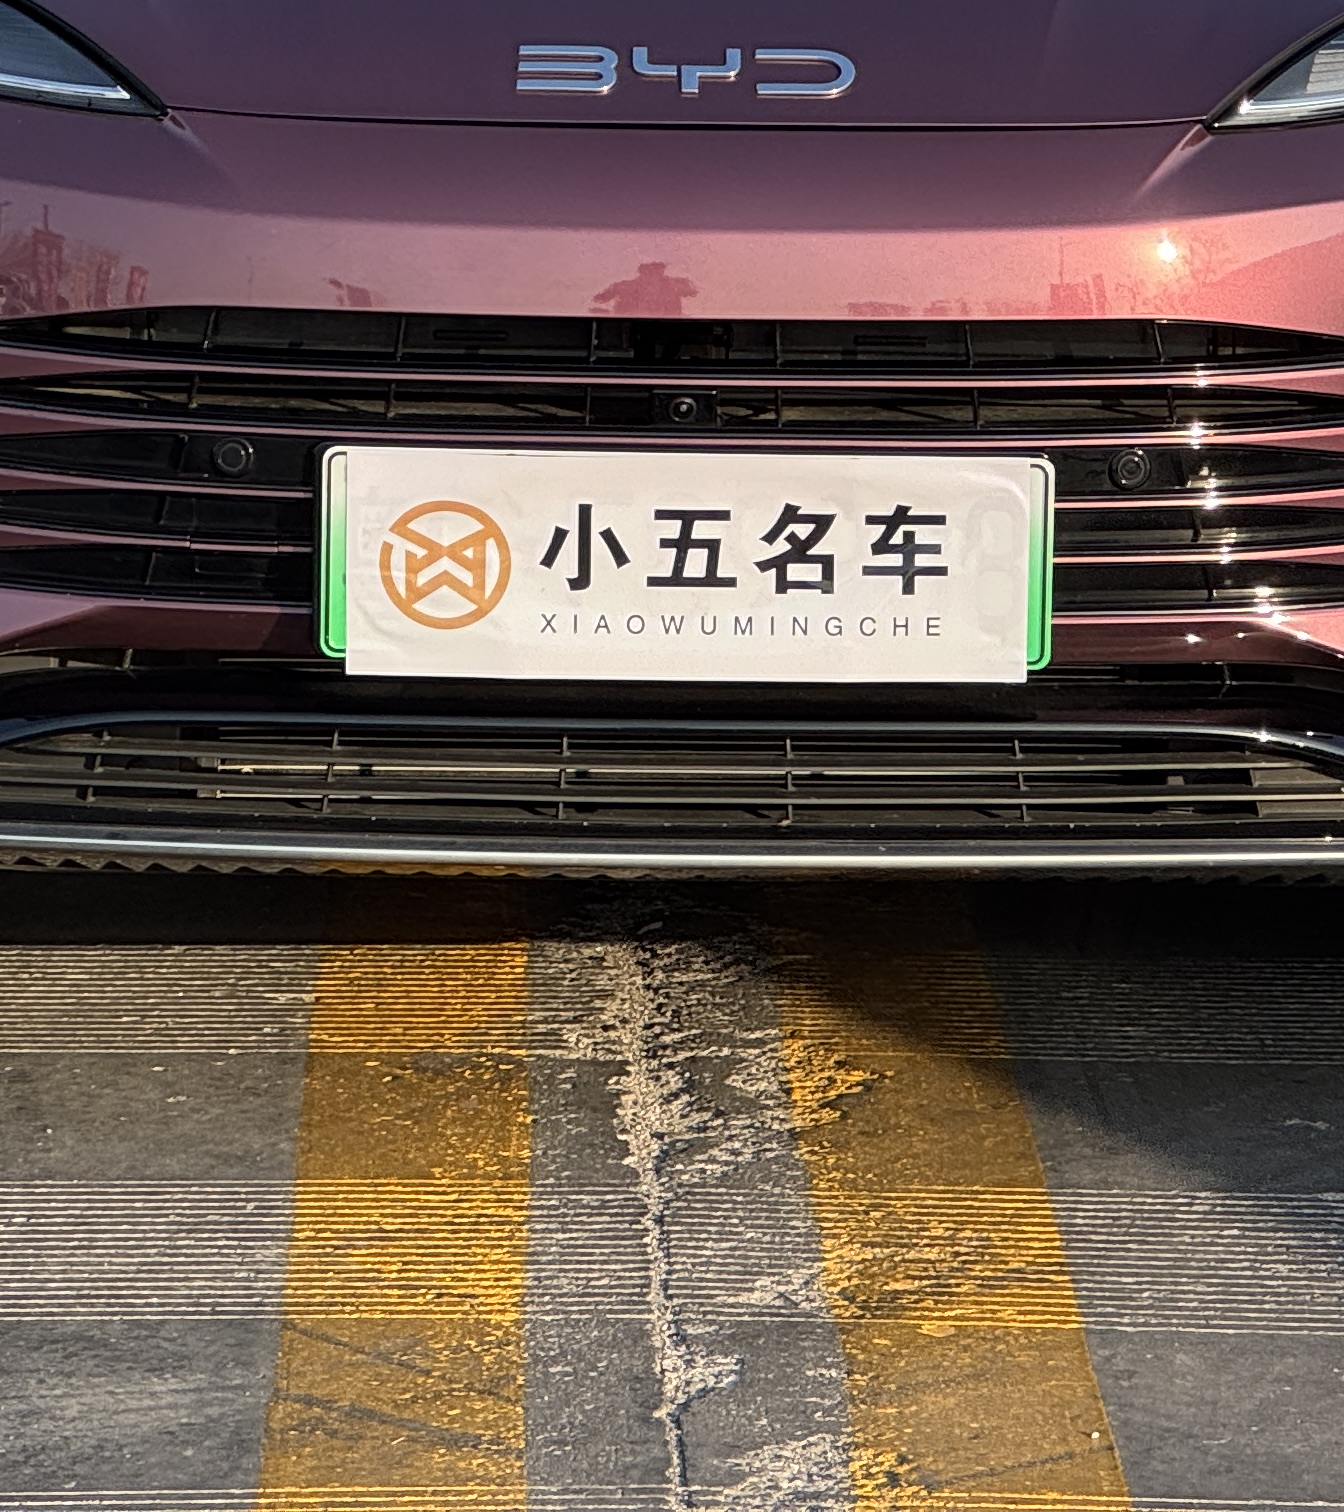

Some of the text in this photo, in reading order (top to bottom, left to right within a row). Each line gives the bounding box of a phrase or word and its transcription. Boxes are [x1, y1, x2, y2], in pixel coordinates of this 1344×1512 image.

[516, 44, 857, 99] BYD
[538, 502, 950, 597] 小五名车
[540, 612, 943, 638] XIAOWUMINGCHE
